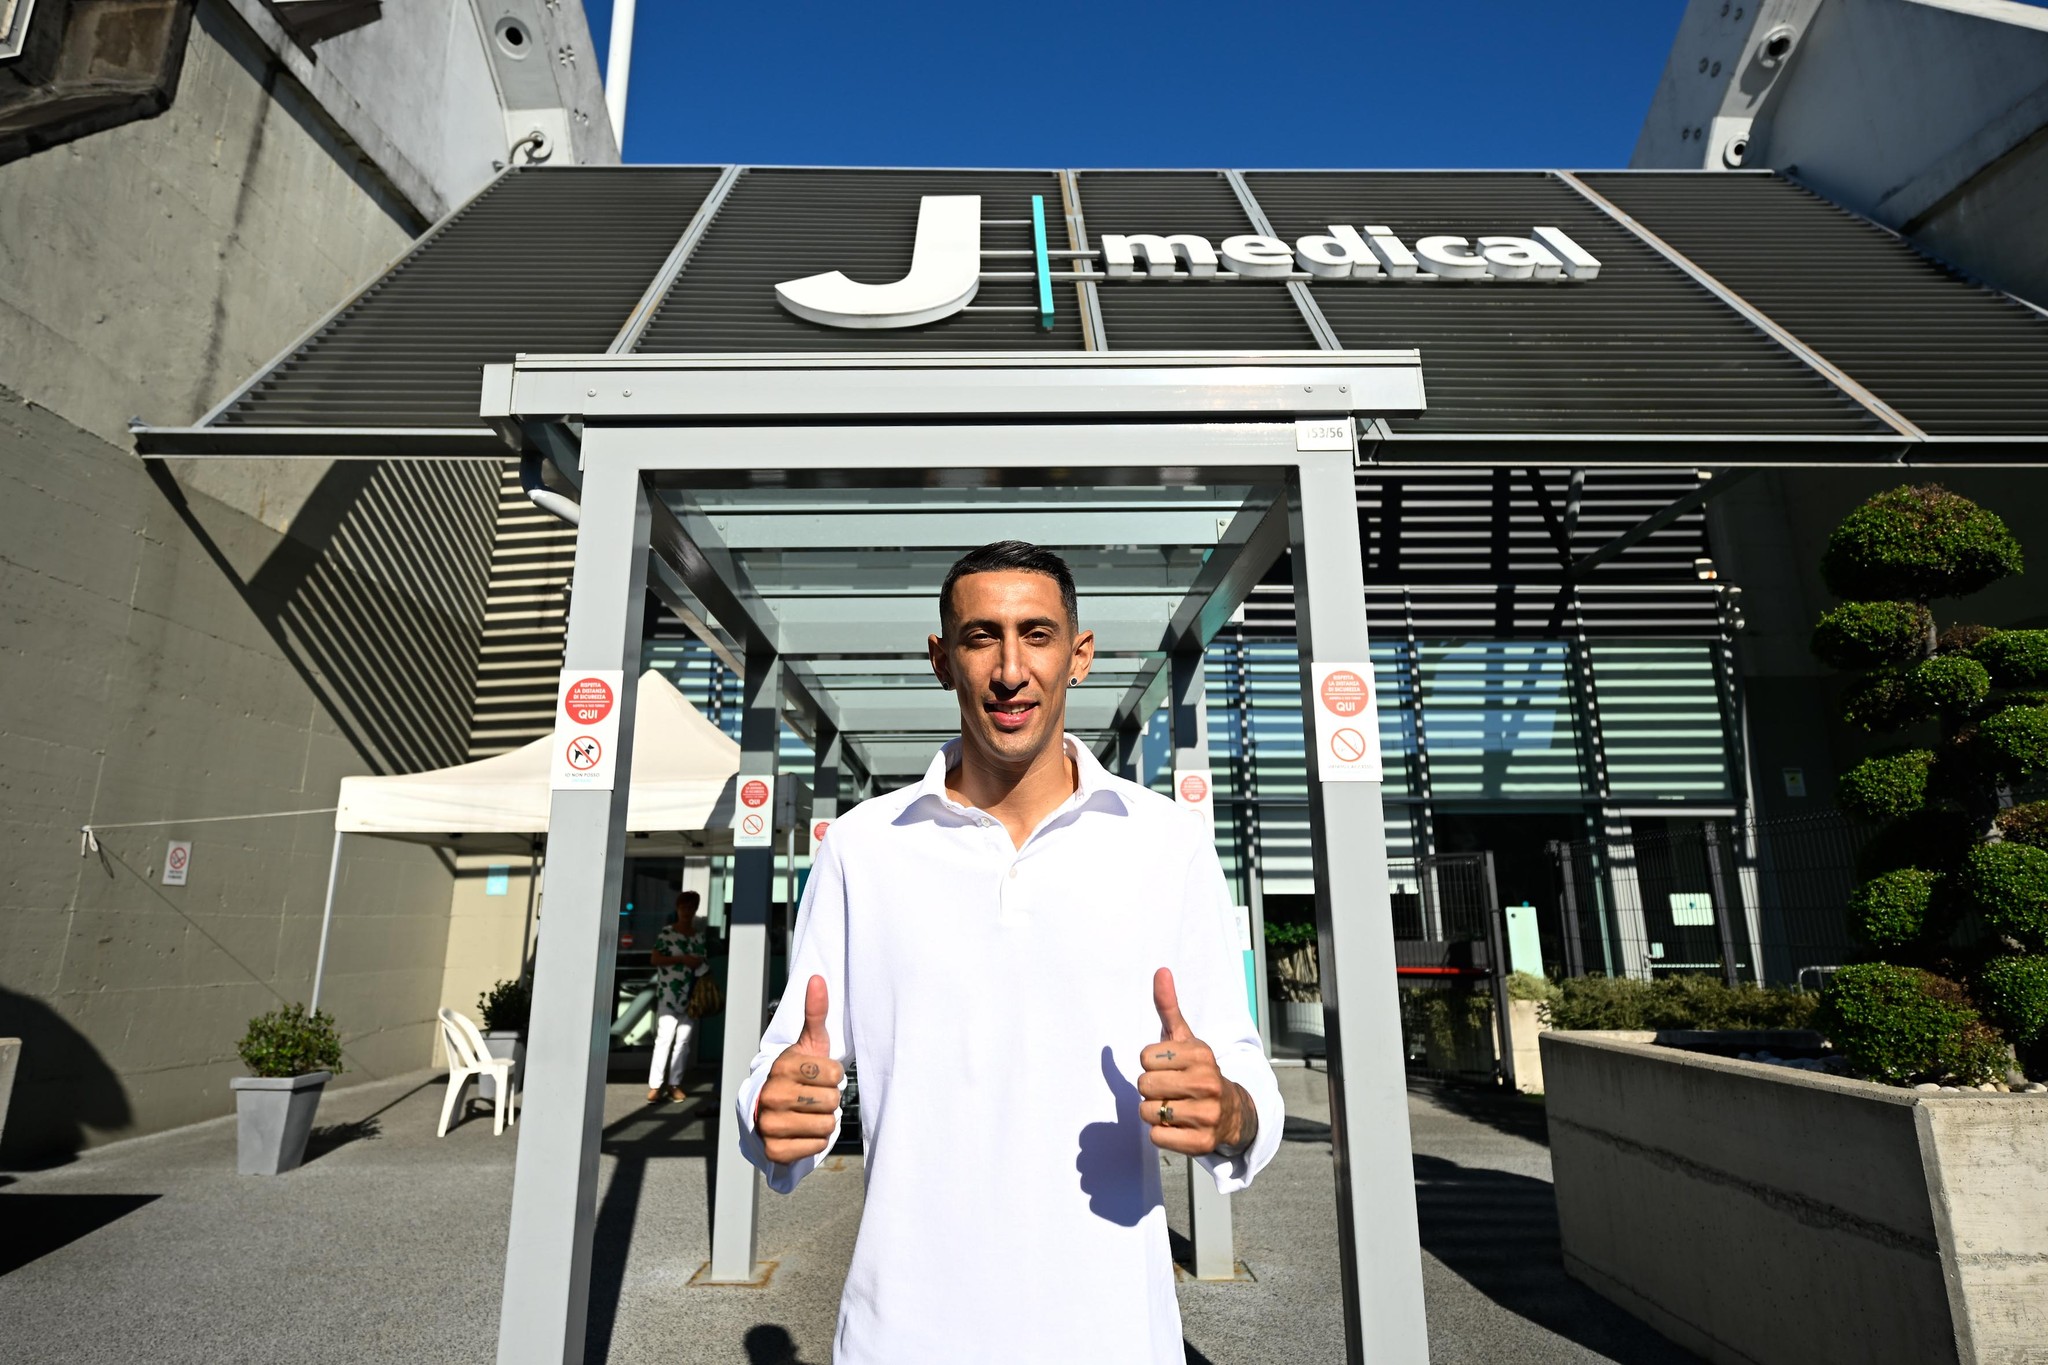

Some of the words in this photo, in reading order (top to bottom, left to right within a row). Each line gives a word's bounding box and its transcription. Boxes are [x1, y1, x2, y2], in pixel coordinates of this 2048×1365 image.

[774, 194, 981, 330] J
[1101, 225, 1602, 278] medical
[1336, 702, 1355, 712] QUI
[578, 709, 598, 720] QUI
